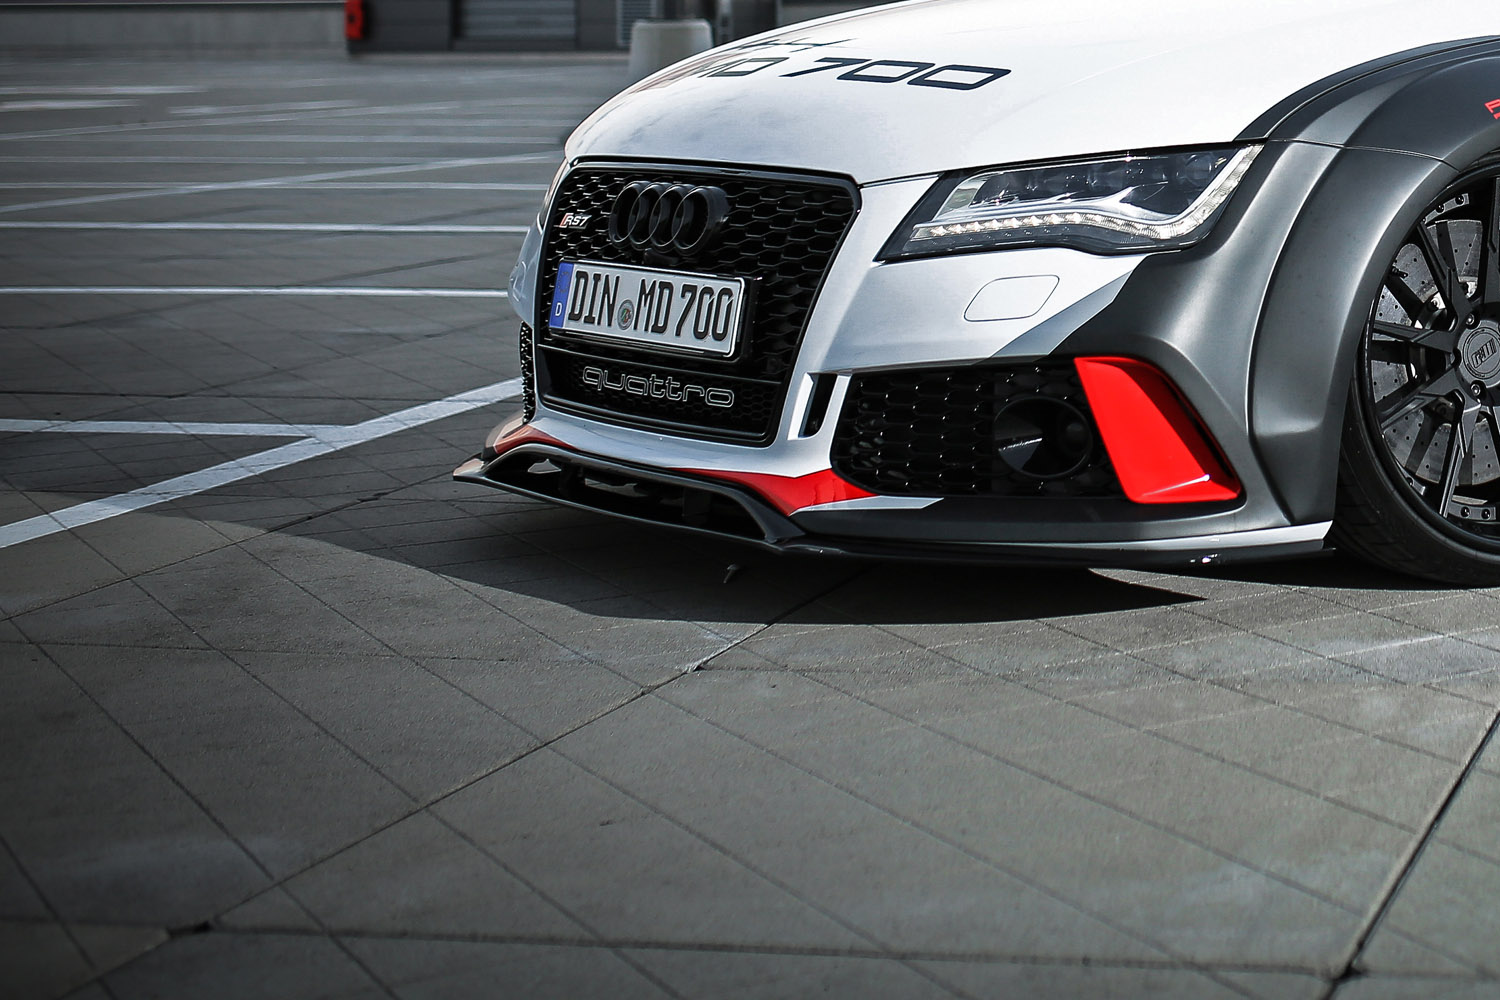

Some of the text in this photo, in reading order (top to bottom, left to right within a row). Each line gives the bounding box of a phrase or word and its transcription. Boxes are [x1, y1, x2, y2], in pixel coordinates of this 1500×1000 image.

[778, 56, 1012, 91] 700
[561, 213, 591, 228] RS7
[554, 302, 563, 317] D
[567, 269, 735, 342] DIN MD 700
[582, 365, 735, 408] quattro
